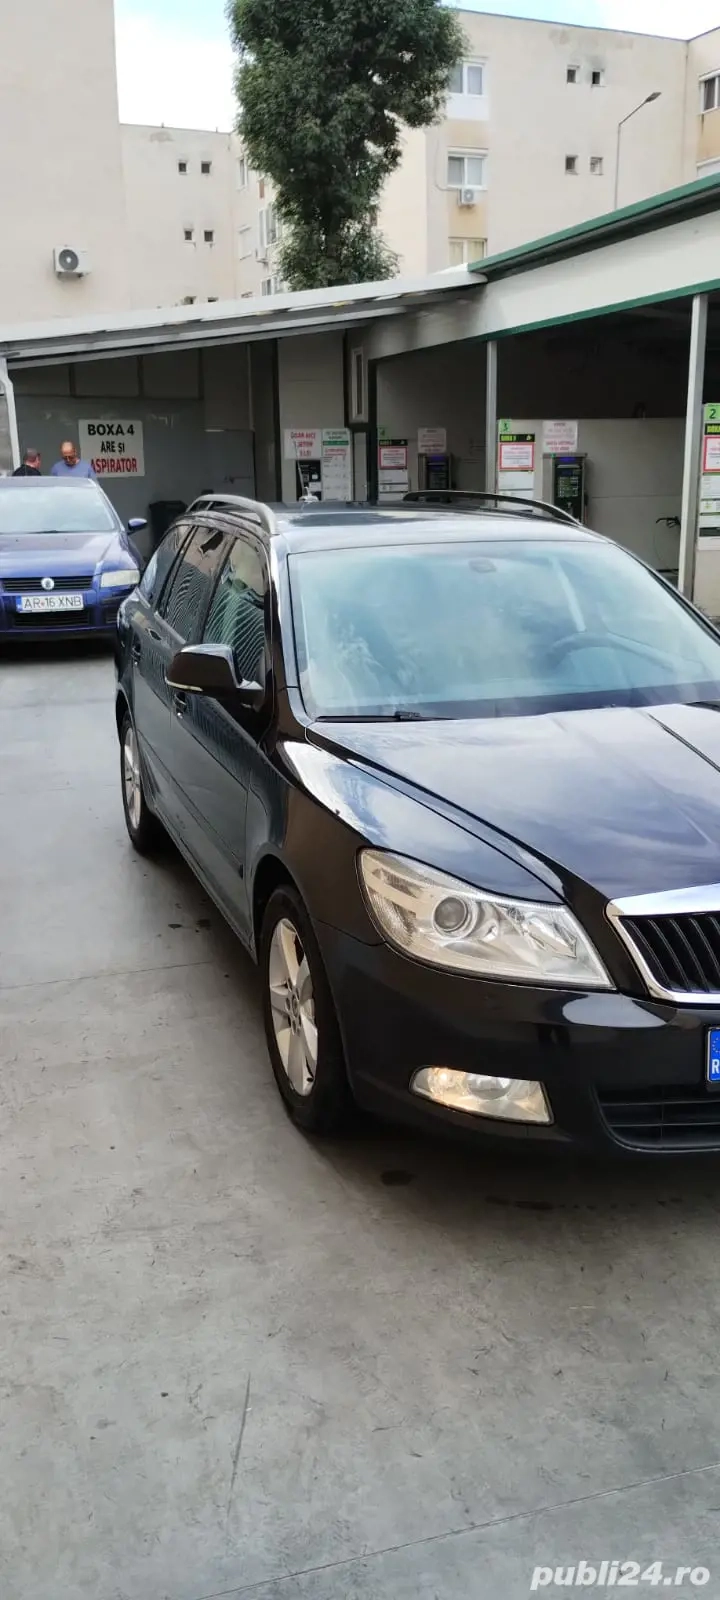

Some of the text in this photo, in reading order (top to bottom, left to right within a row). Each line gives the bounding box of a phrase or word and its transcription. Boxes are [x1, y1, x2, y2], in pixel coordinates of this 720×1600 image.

[709, 408, 717, 419] 2
[87, 423, 135, 436] BOXA 4
[100, 440, 116, 453] ARE
[24, 597, 41, 609] AR
[58, 595, 82, 607] XNB
